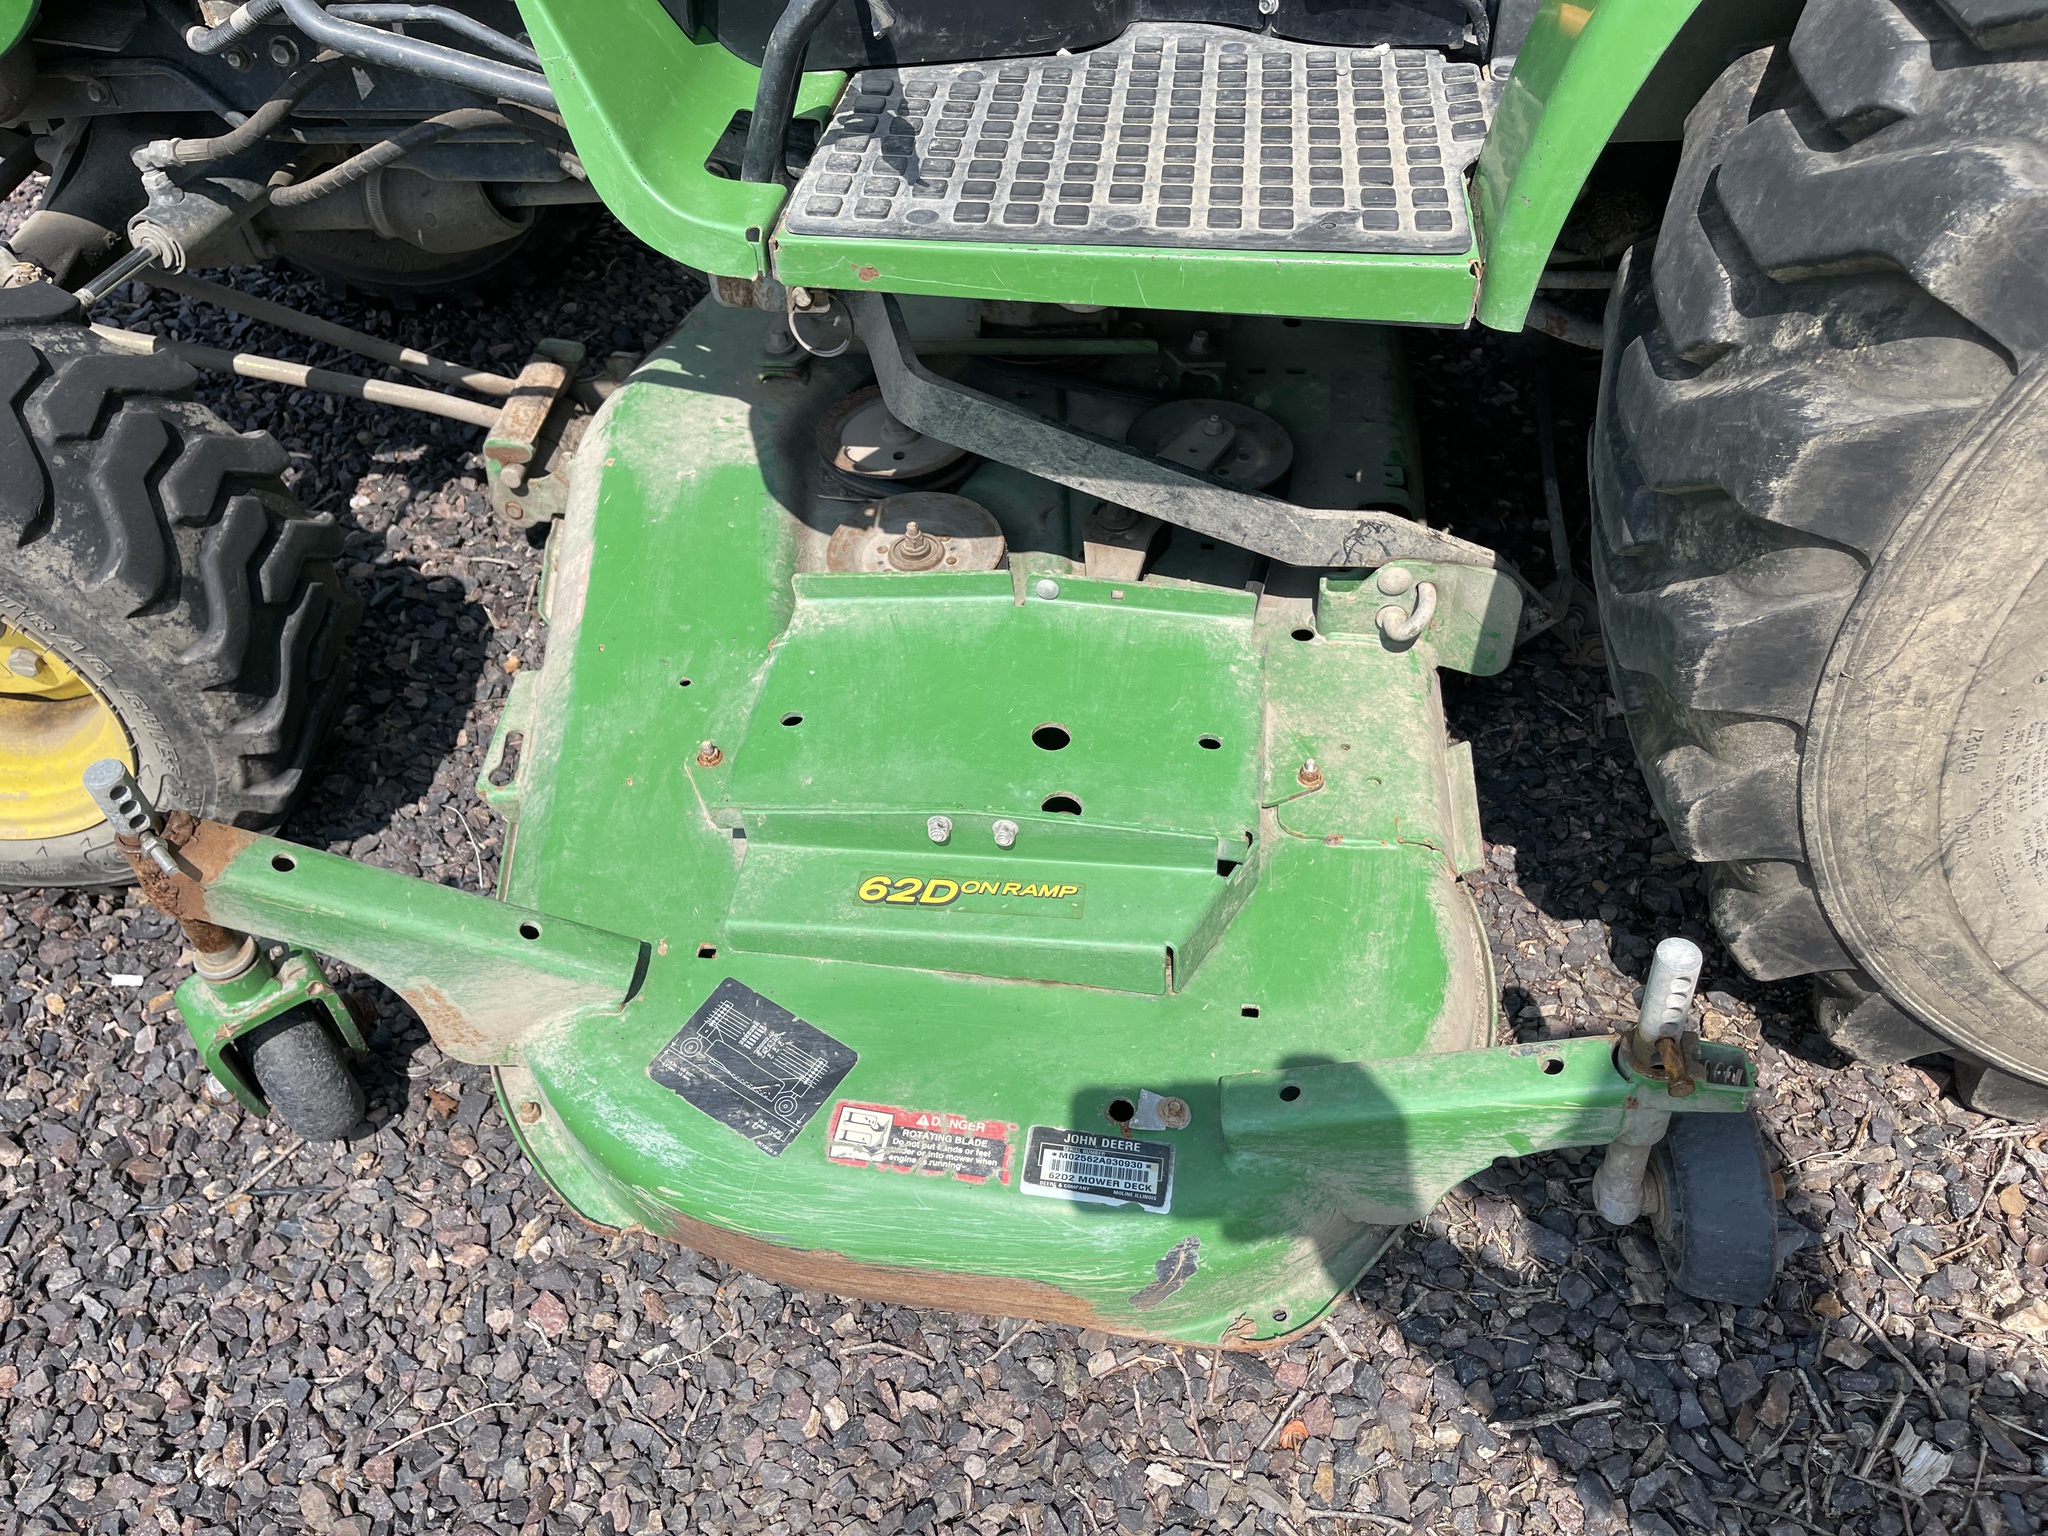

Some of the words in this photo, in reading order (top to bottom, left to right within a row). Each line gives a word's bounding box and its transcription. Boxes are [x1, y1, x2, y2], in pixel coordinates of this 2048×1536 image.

[858, 876, 961, 906] 62D
[961, 880, 1001, 895] ON
[1002, 882, 1079, 899] RAMP
[931, 1116, 986, 1133] DNGER
[892, 1137, 904, 1145] Do
[906, 1140, 920, 1148] not
[922, 1142, 936, 1151] put
[976, 1148, 992, 1157] feet
[902, 1128, 953, 1143] ROTATING
[955, 1136, 989, 1148] BLADE
[1063, 1133, 1097, 1146] JOHN
[1101, 1138, 1141, 1152] DEERE
[888, 1154, 917, 1163] engine
[928, 1150, 944, 1159] into
[945, 1154, 974, 1163] mower
[975, 1158, 998, 1167] when
[1048, 1172, 1075, 1182] 62D2
[1078, 1175, 1120, 1188] MOWER
[1124, 1181, 1153, 1192] DECK
